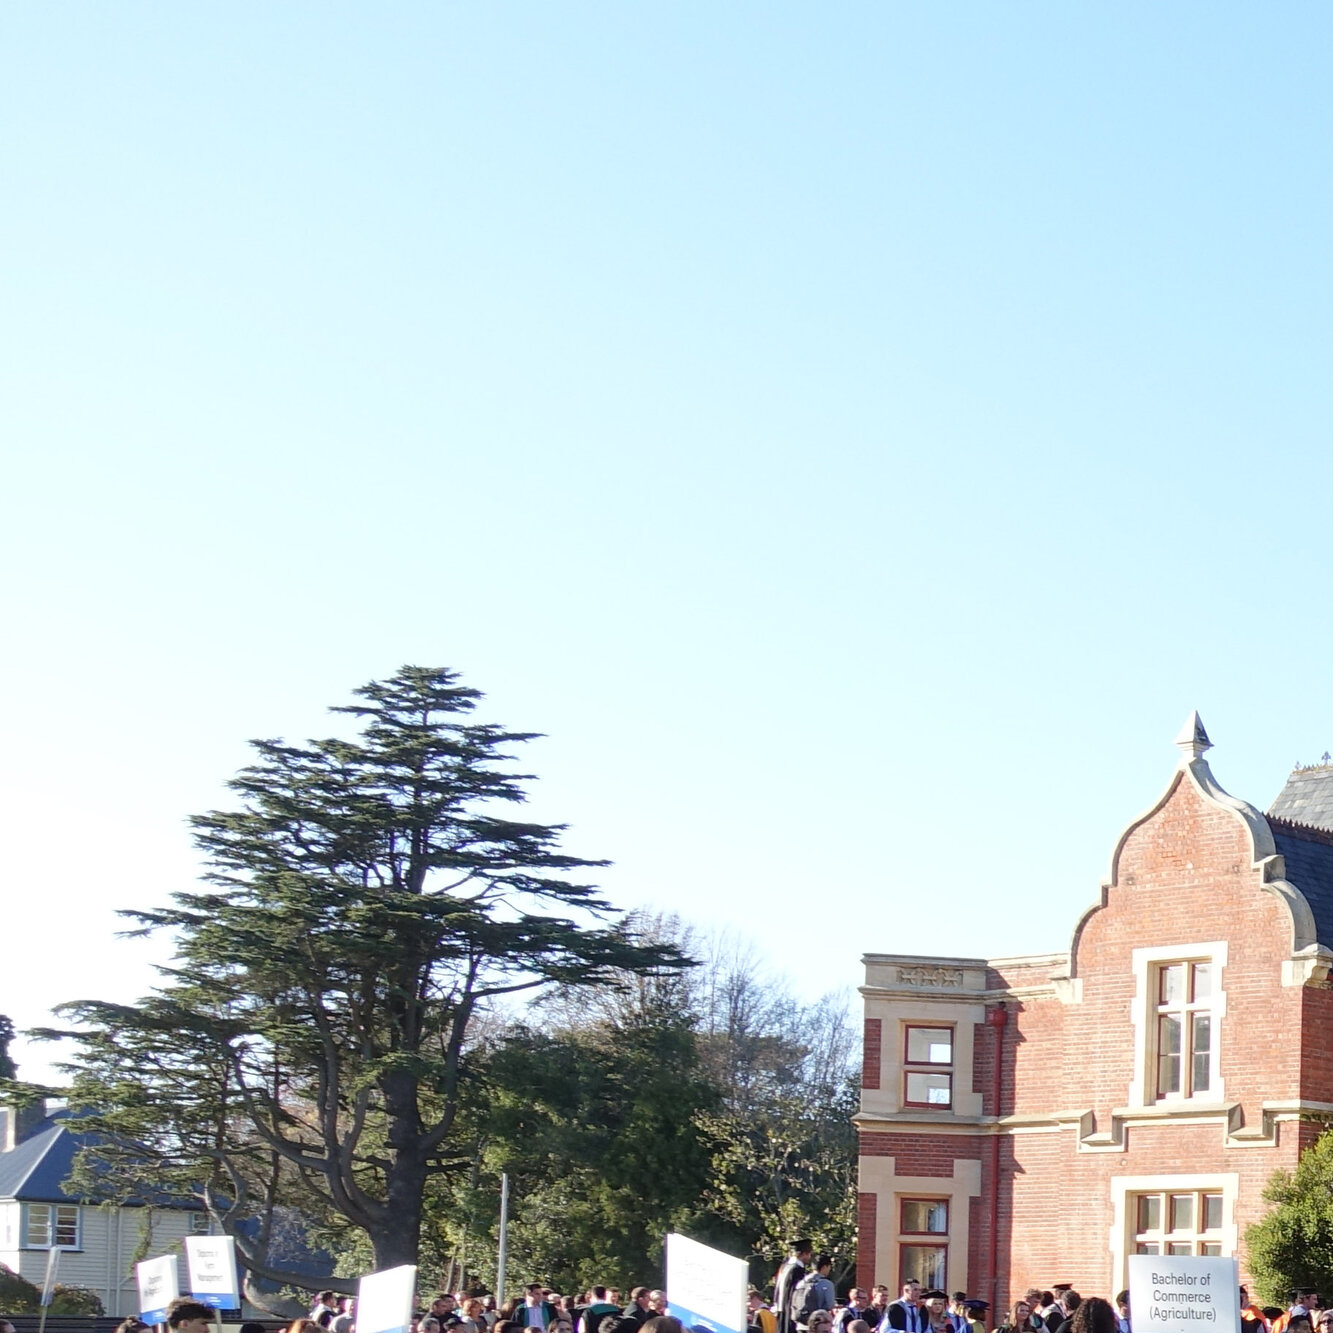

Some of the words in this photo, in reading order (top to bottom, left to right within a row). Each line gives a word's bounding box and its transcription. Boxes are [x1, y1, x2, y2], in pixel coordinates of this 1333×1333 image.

[1151, 1272, 1198, 1286] Bachelor
[1200, 1273, 1211, 1286] of
[1153, 1289, 1212, 1303] Commerce
[1149, 1306, 1217, 1323] (Agriculture)
